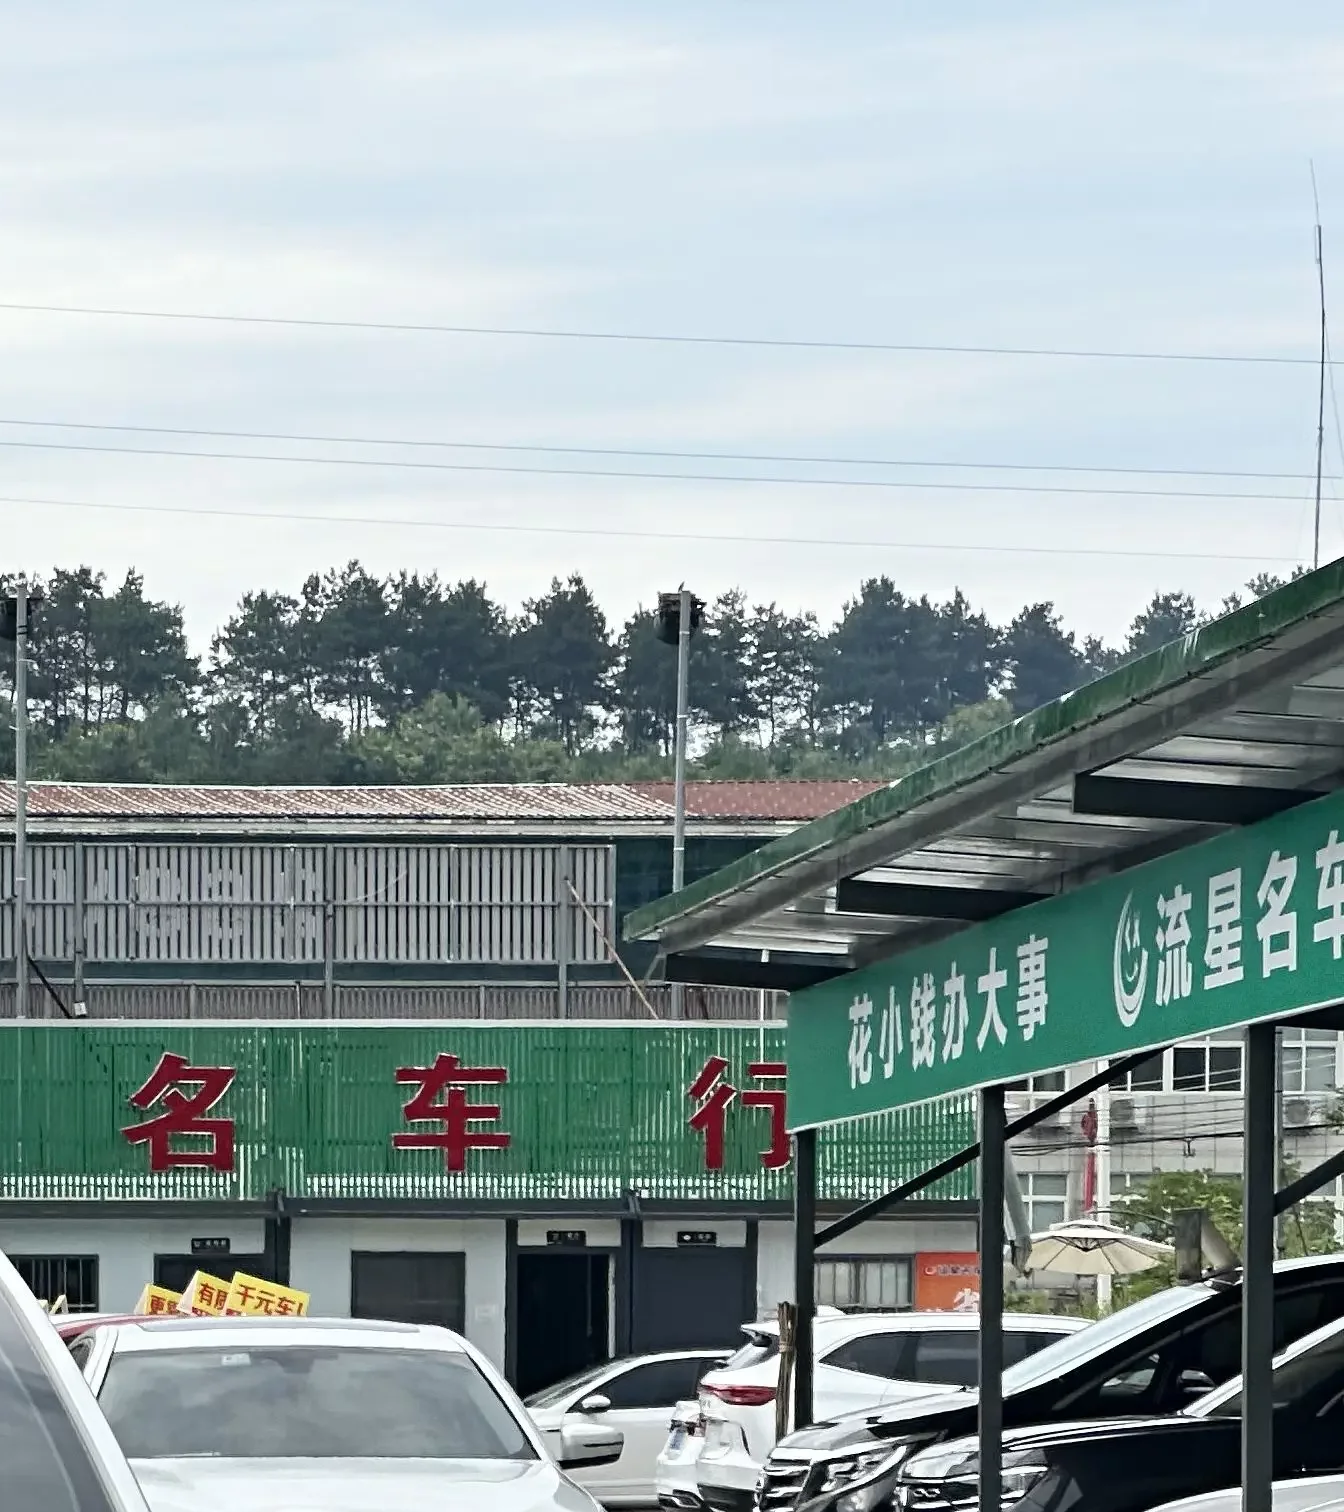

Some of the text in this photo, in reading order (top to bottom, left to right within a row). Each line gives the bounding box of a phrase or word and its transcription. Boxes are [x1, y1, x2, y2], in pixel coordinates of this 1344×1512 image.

[1155, 830, 1344, 1007] 流星名车
[847, 934, 1050, 1090] 花小钱办大事
